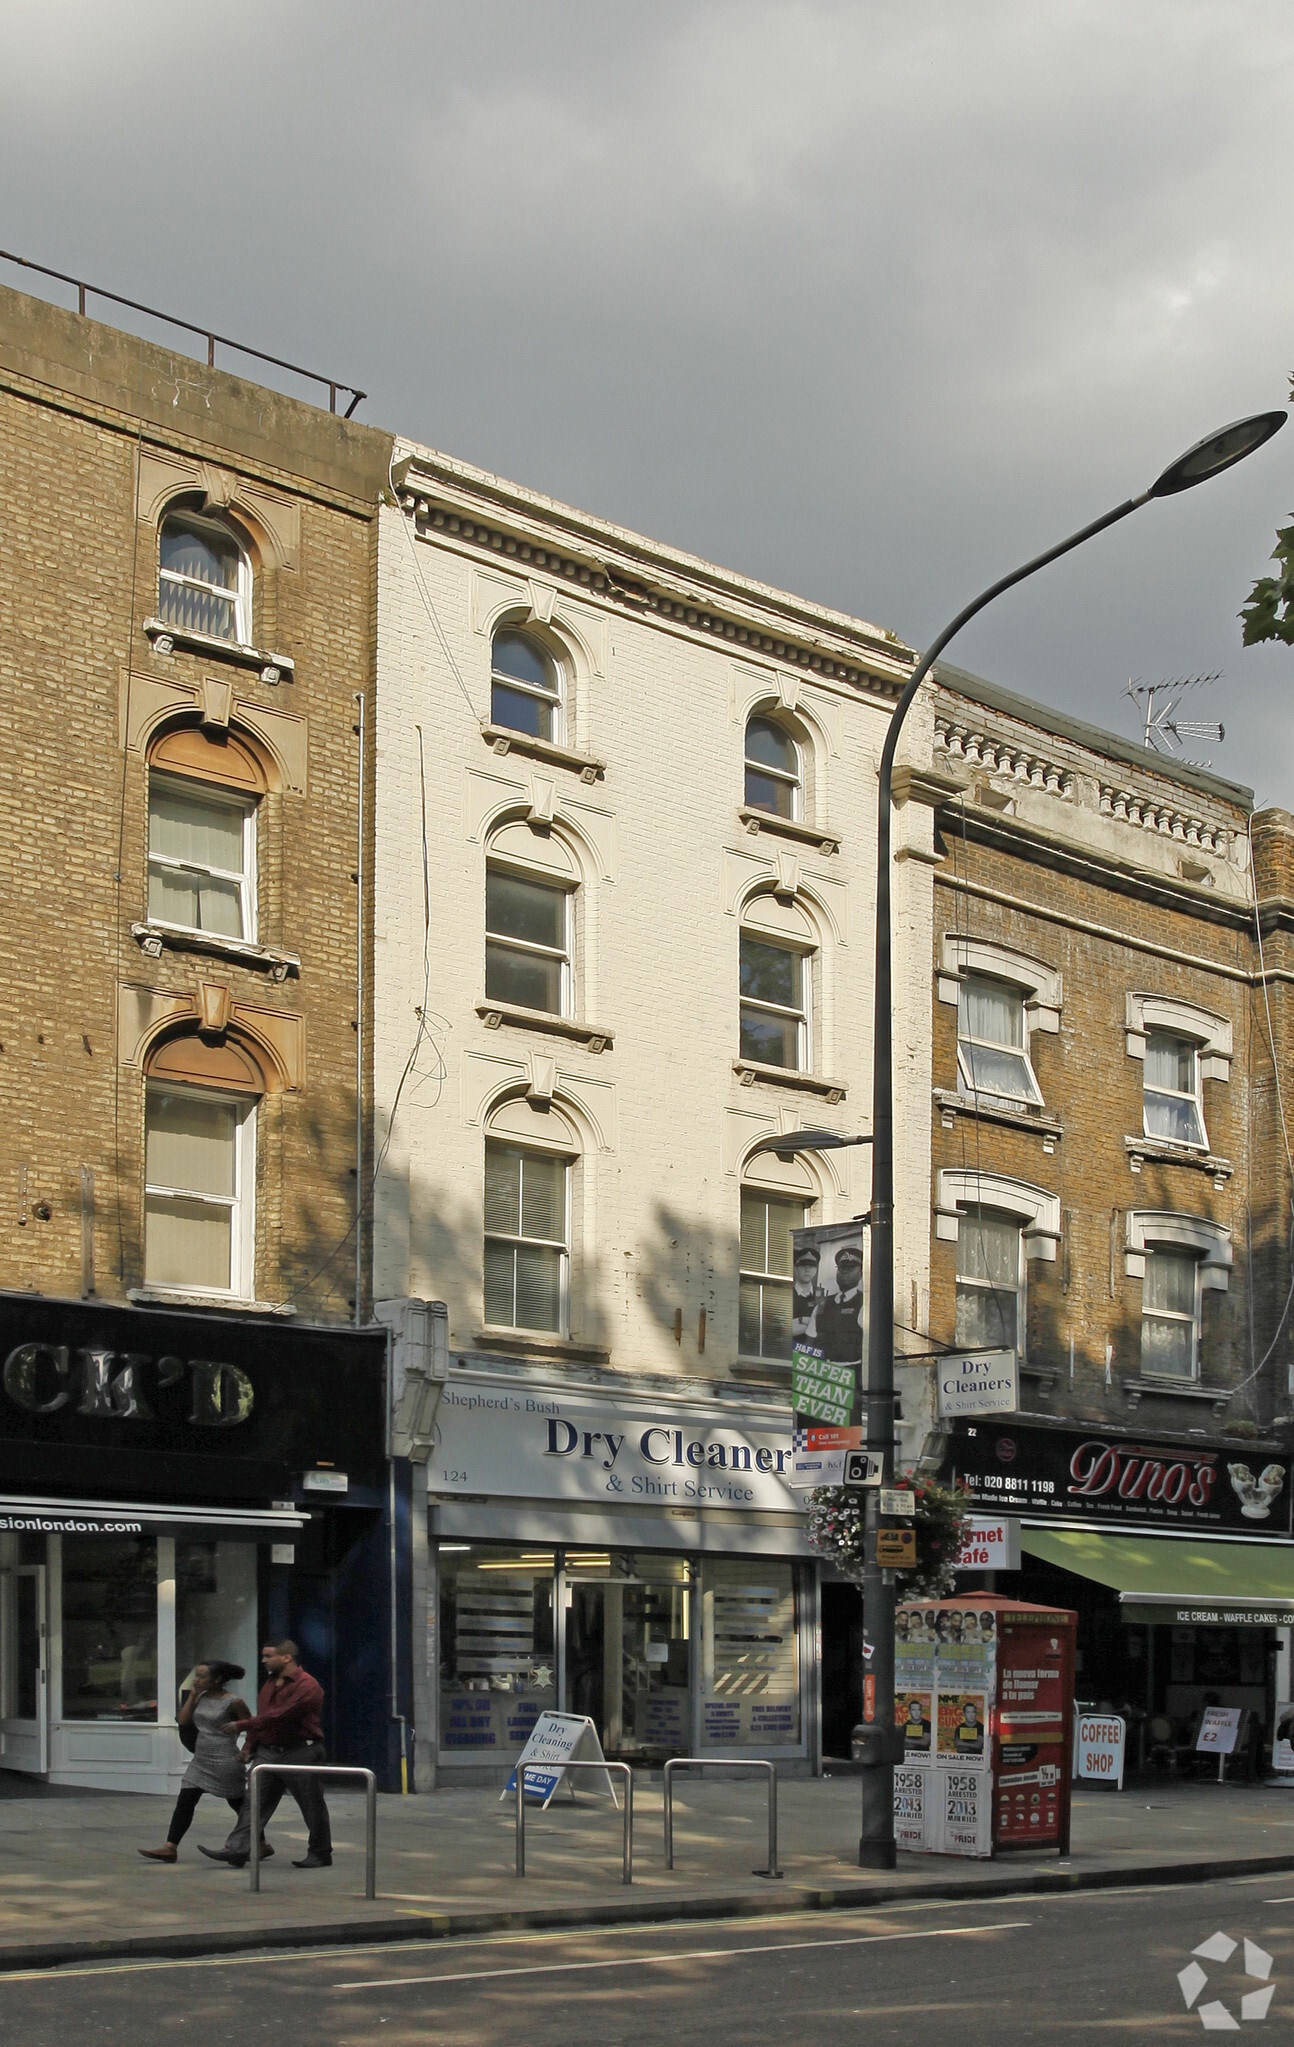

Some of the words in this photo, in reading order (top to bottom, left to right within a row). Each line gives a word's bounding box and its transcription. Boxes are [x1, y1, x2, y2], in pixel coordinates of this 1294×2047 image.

[795, 1343, 812, 1354] H&F
[812, 1349, 823, 1358] IS
[796, 1357, 853, 1385] SAFER
[962, 1361, 991, 1376] Dry
[795, 1374, 850, 1405] THAN
[943, 1379, 1012, 1394] Cleaners
[442, 1391, 520, 1411] Shepherd's
[526, 1399, 560, 1414] Bush
[795, 1395, 847, 1425] EVER
[945, 1403, 953, 1411] &
[955, 1400, 976, 1409] Shirt
[978, 1398, 1010, 1408] Service
[968, 1428, 977, 1437] 22
[544, 1417, 626, 1471] Dry
[443, 1470, 468, 1481] 124
[1067, 1440, 1218, 1506] Dino's
[606, 1474, 623, 1492] &
[632, 1476, 678, 1496] Shirt
[684, 1480, 753, 1501] Service
[964, 1473, 982, 1487] Tel:
[984, 1475, 1003, 1489] 020
[1005, 1477, 1028, 1491] 8811
[1031, 1480, 1055, 1493] 1198
[982, 1493, 998, 1501] Made
[1009, 1495, 1028, 1504] Cream
[967, 1527, 1003, 1543] rnet
[1177, 1611, 1190, 1621] ICE
[1191, 1612, 1219, 1622] CREAM
[1223, 1613, 1253, 1623] WAFFLE
[1254, 1613, 1278, 1623] CAKES
[938, 1694, 960, 1703] NME
[938, 1706, 963, 1716] BIG
[938, 1716, 964, 1727] GUNS
[548, 1723, 567, 1736] Dry
[1082, 1723, 1119, 1744] COFFEE
[1202, 1732, 1217, 1742] £2
[532, 1733, 573, 1751] Cleaning
[530, 1748, 538, 1757] &
[540, 1749, 560, 1760] Shirt
[1086, 1752, 1113, 1773] SHOP
[536, 1775, 553, 1785] DAY
[894, 1773, 922, 1788] 1958
[947, 1776, 977, 1791] 1958
[894, 1787, 922, 1795] ARRESTED
[947, 1790, 977, 1799] ARRESTED
[894, 1796, 922, 1812] 2013
[947, 1800, 977, 1816] 2013
[947, 1815, 977, 1823] MARRIED
[900, 1830, 922, 1840] PRIDE
[954, 1833, 976, 1844] PRIDE
